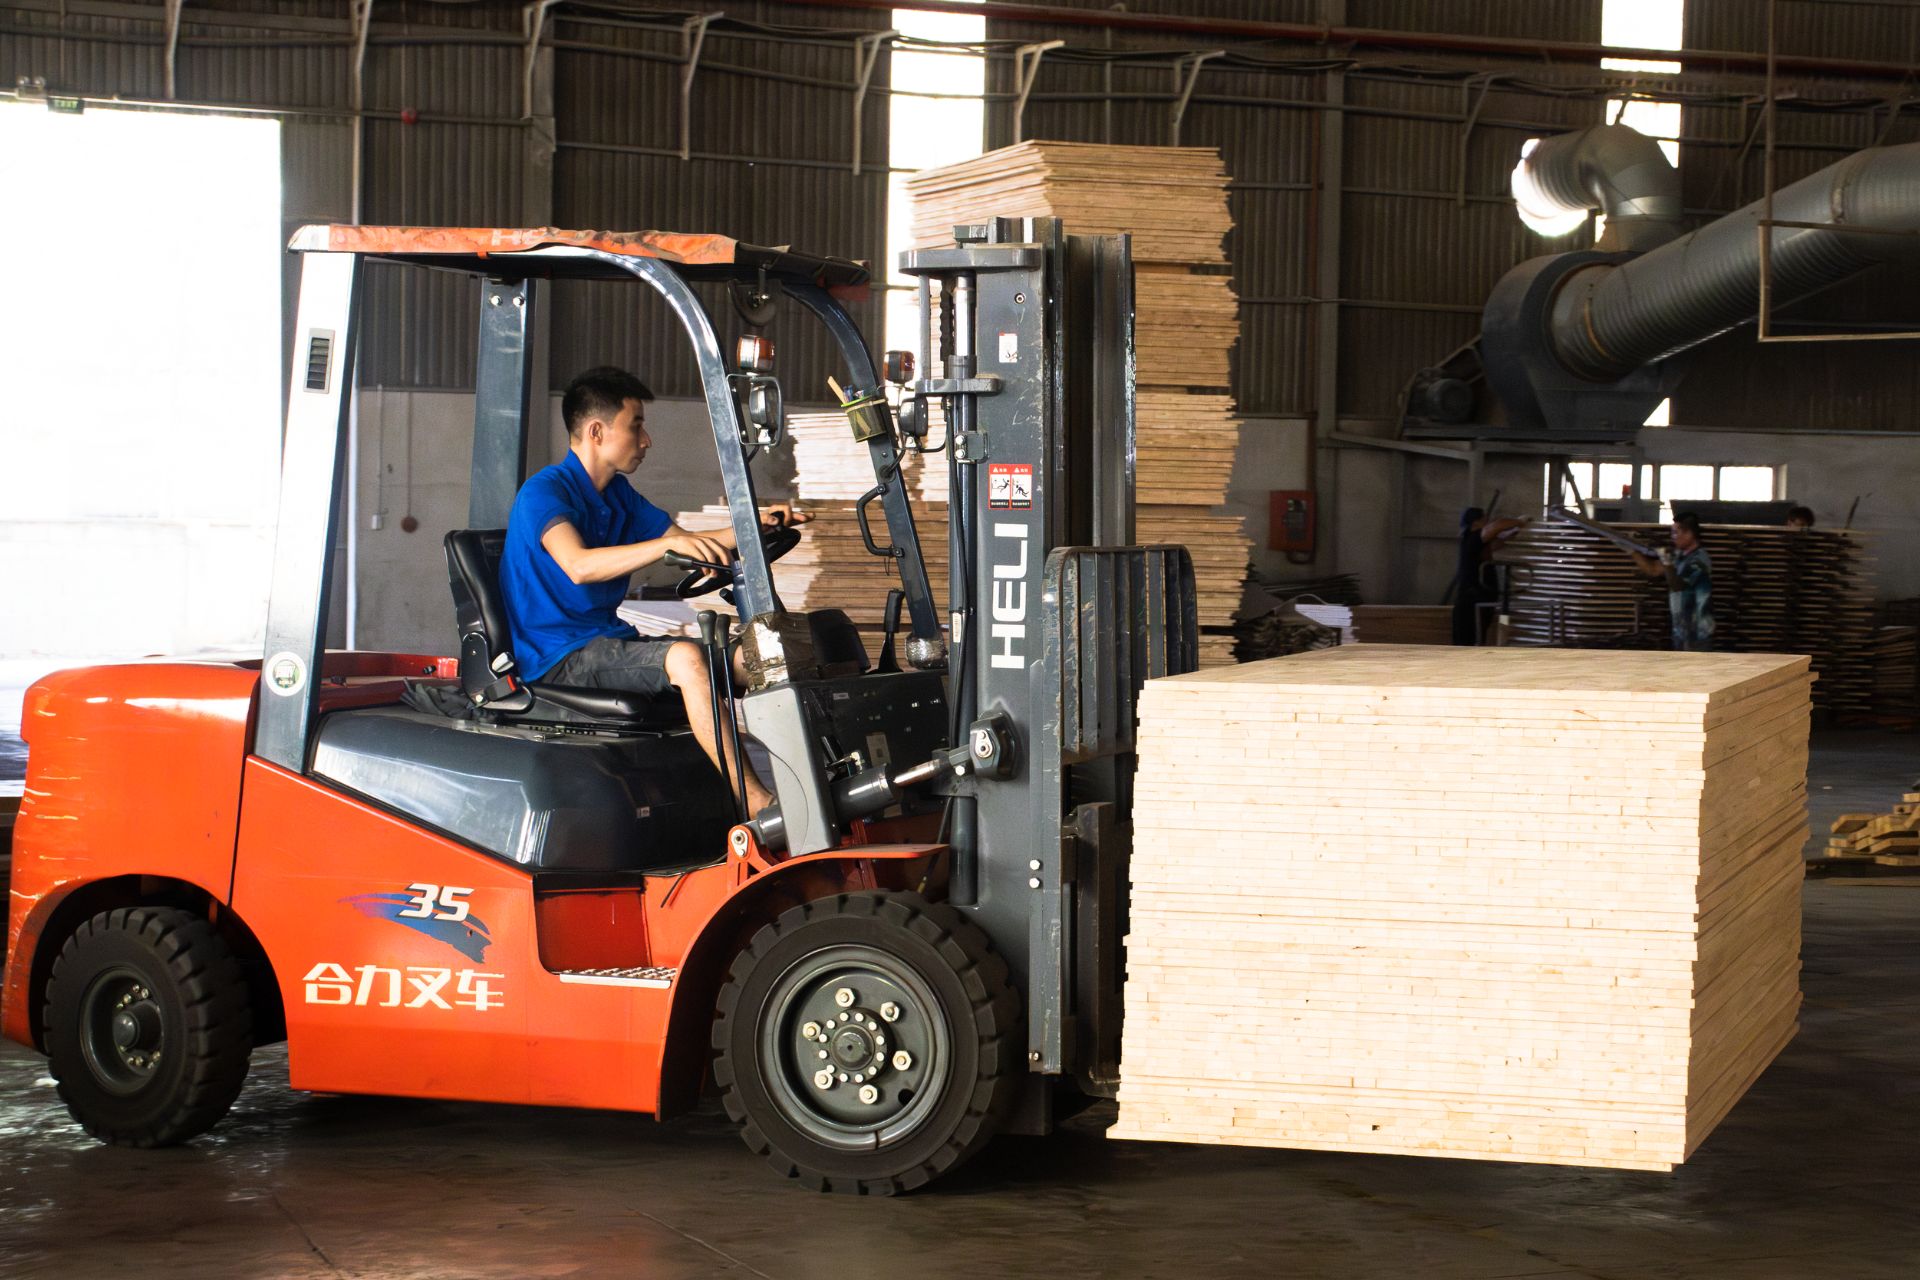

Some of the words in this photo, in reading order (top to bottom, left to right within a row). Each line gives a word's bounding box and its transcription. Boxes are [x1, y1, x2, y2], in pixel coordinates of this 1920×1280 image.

[991, 523, 1029, 669] HELI
[398, 882, 475, 922] 35
[302, 962, 505, 1011] 合力叉车
